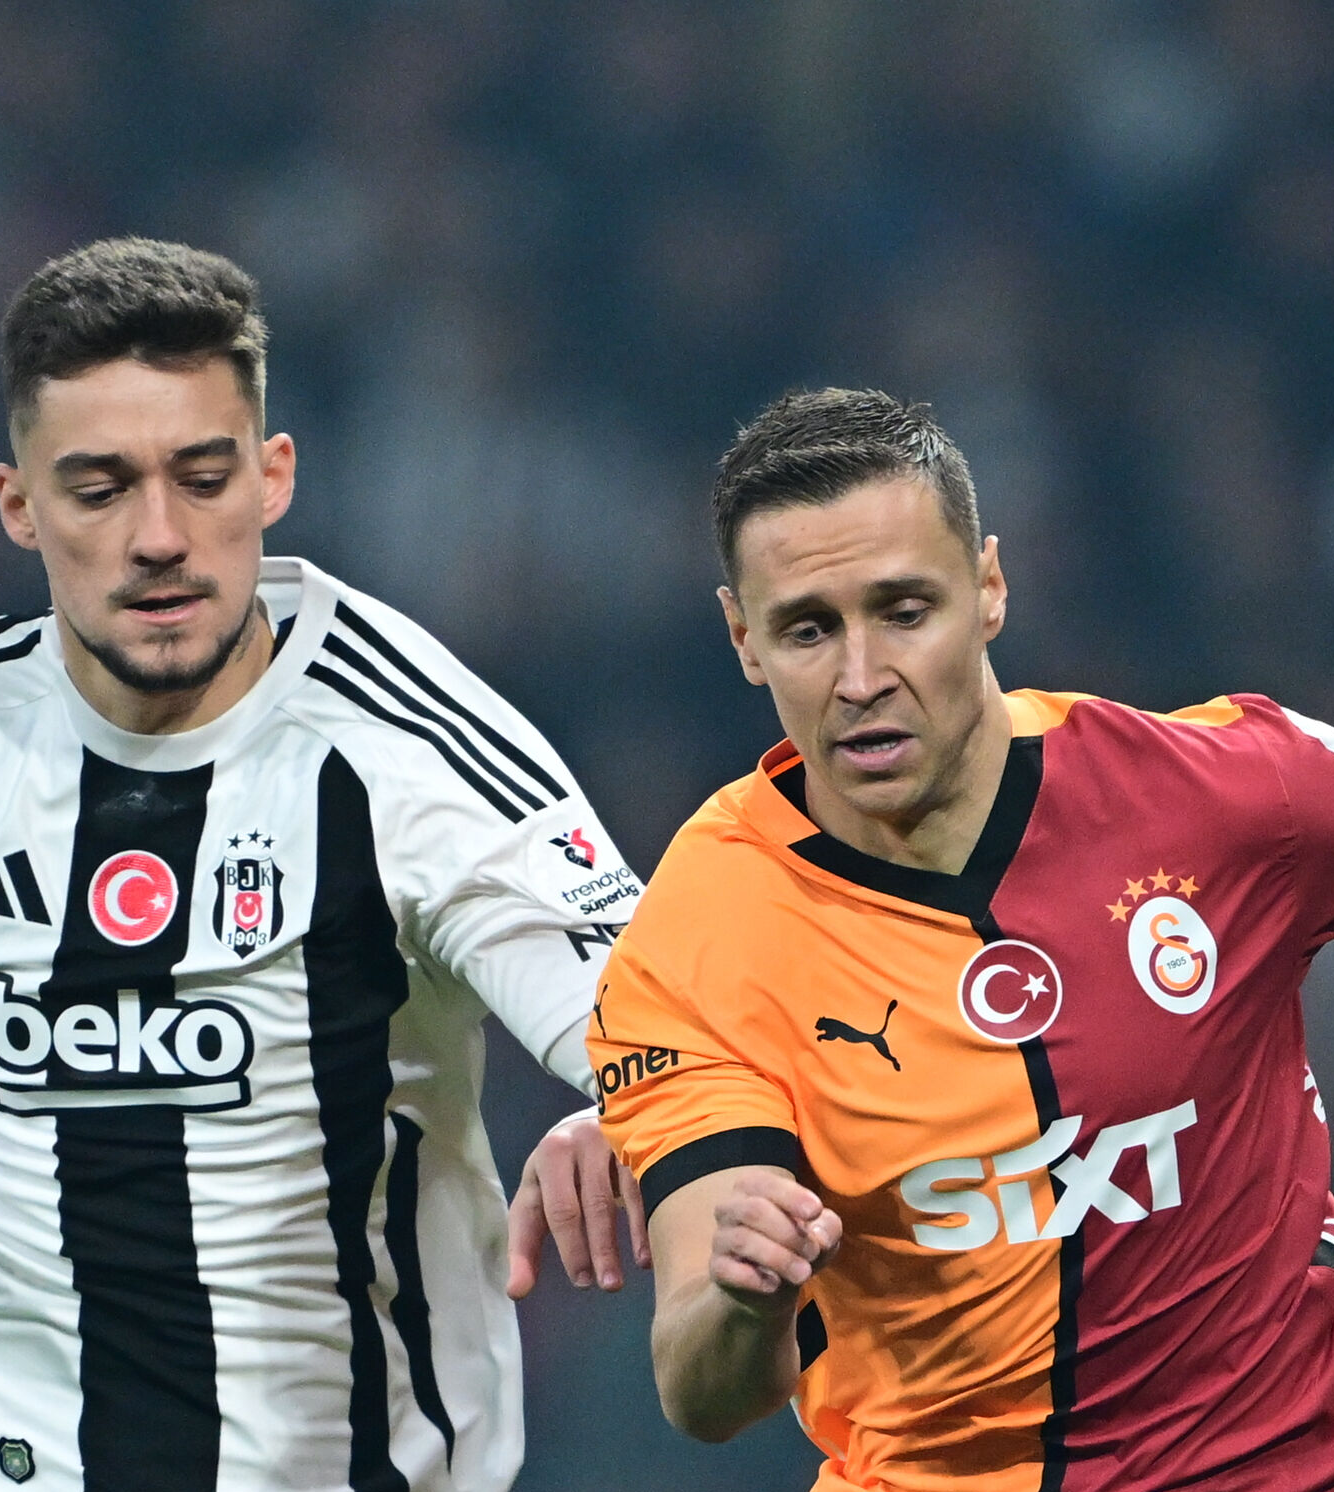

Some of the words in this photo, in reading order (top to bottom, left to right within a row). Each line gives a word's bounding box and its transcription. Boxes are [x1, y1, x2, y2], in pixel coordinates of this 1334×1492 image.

[226, 865, 272, 888] BJK
[562, 863, 633, 903] trendyo
[226, 931, 268, 946] 1903
[1166, 956, 1187, 971] 1905
